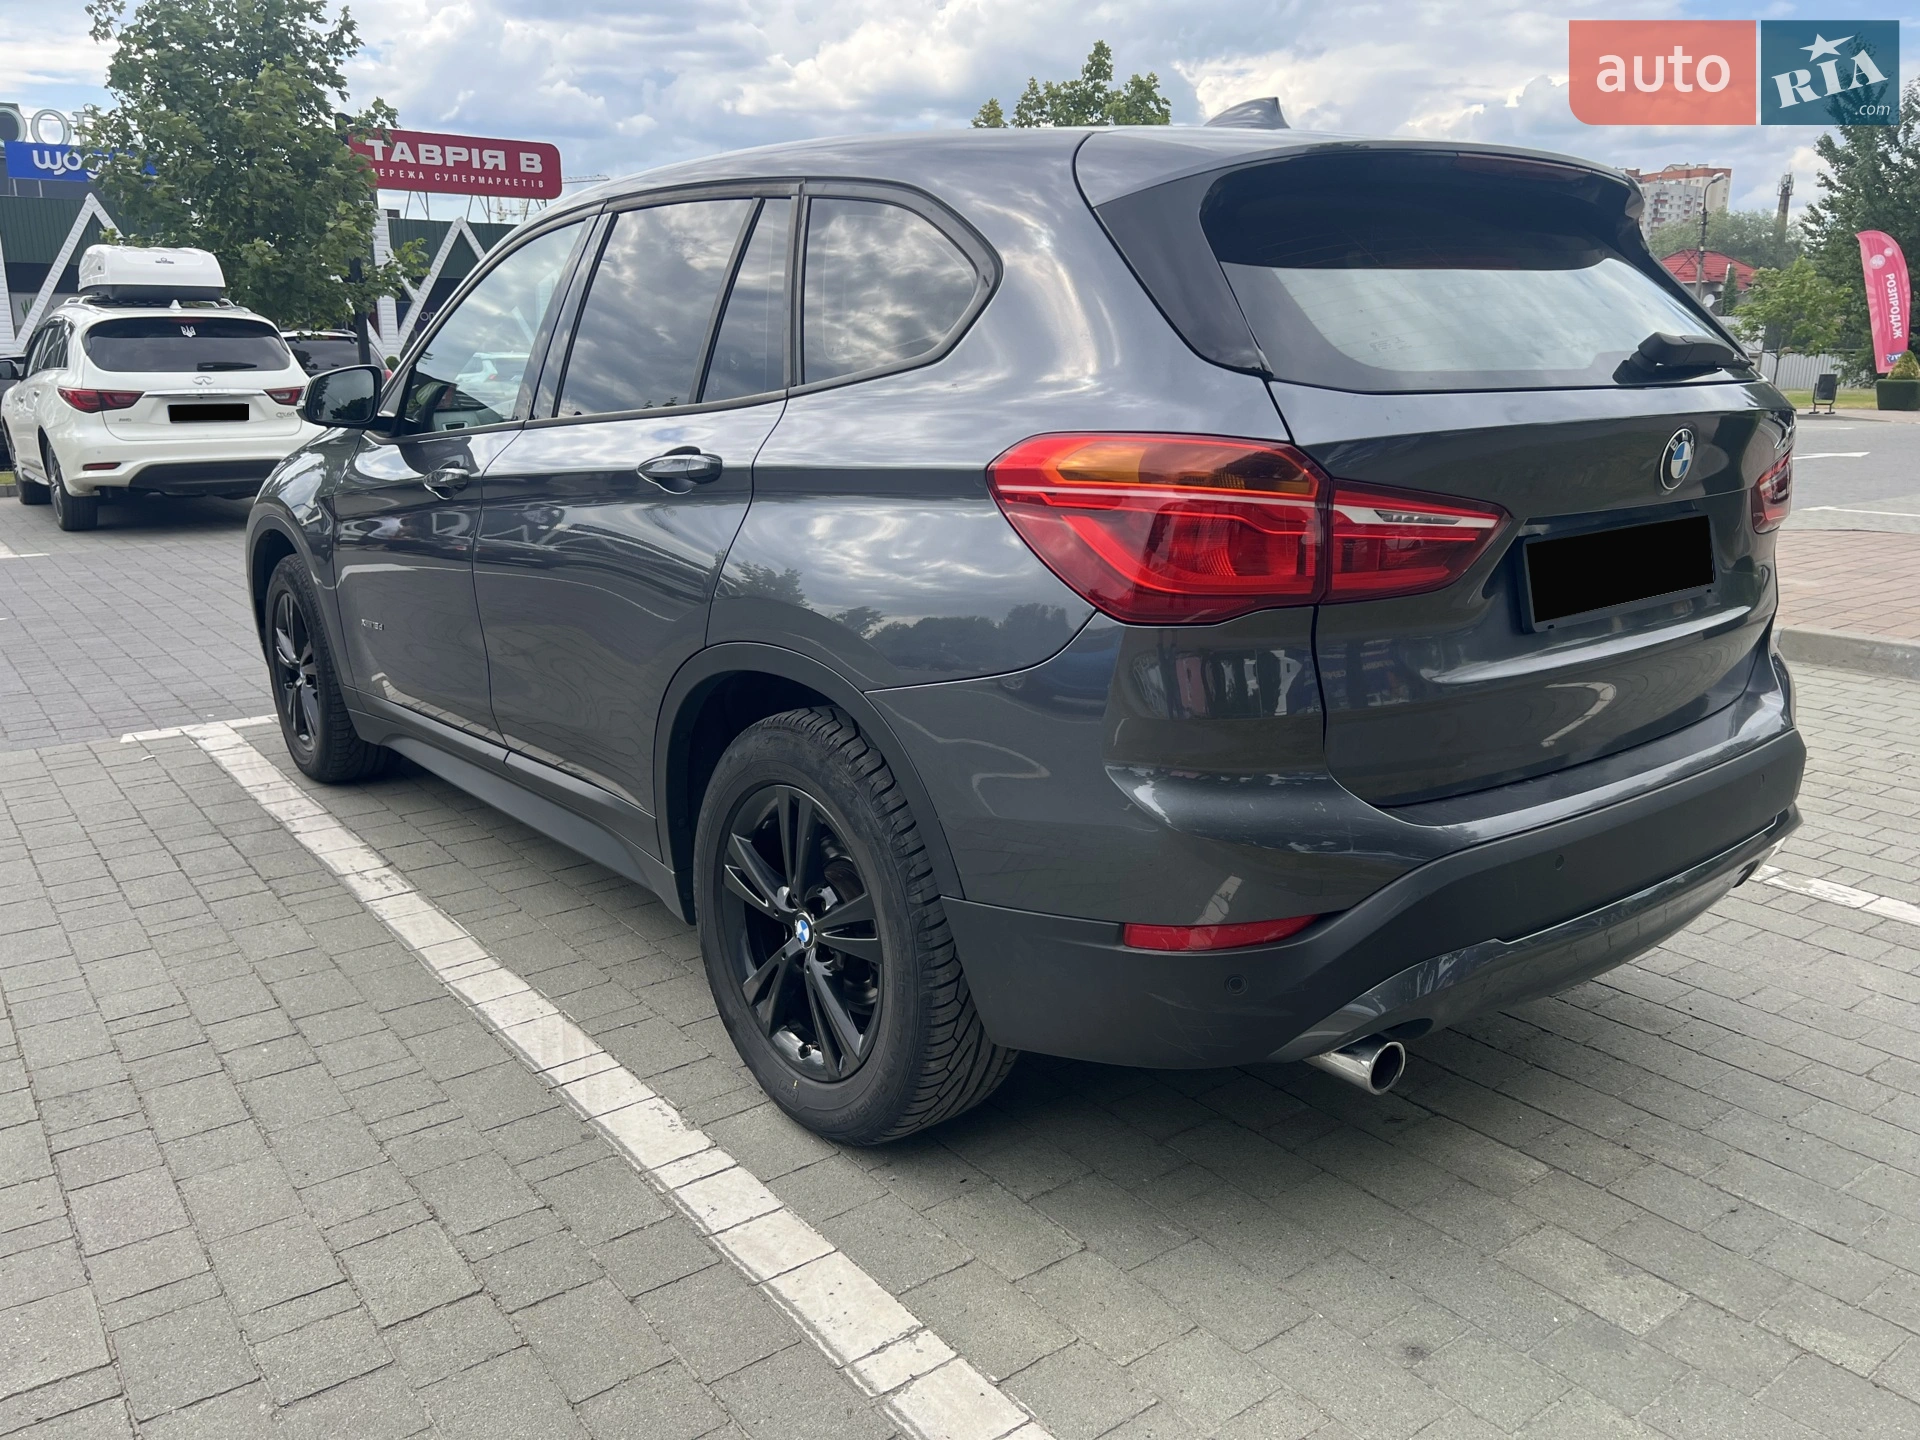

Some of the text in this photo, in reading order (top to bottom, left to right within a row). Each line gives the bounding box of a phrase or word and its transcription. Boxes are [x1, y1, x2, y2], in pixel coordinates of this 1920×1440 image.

[365, 139, 543, 174] ТАВРІЯ В
[371, 167, 544, 189] ЕРЕЖА СУПЕРМАРКЕТІВ
[1886, 273, 1902, 339] РОЗПРОДАЖ
